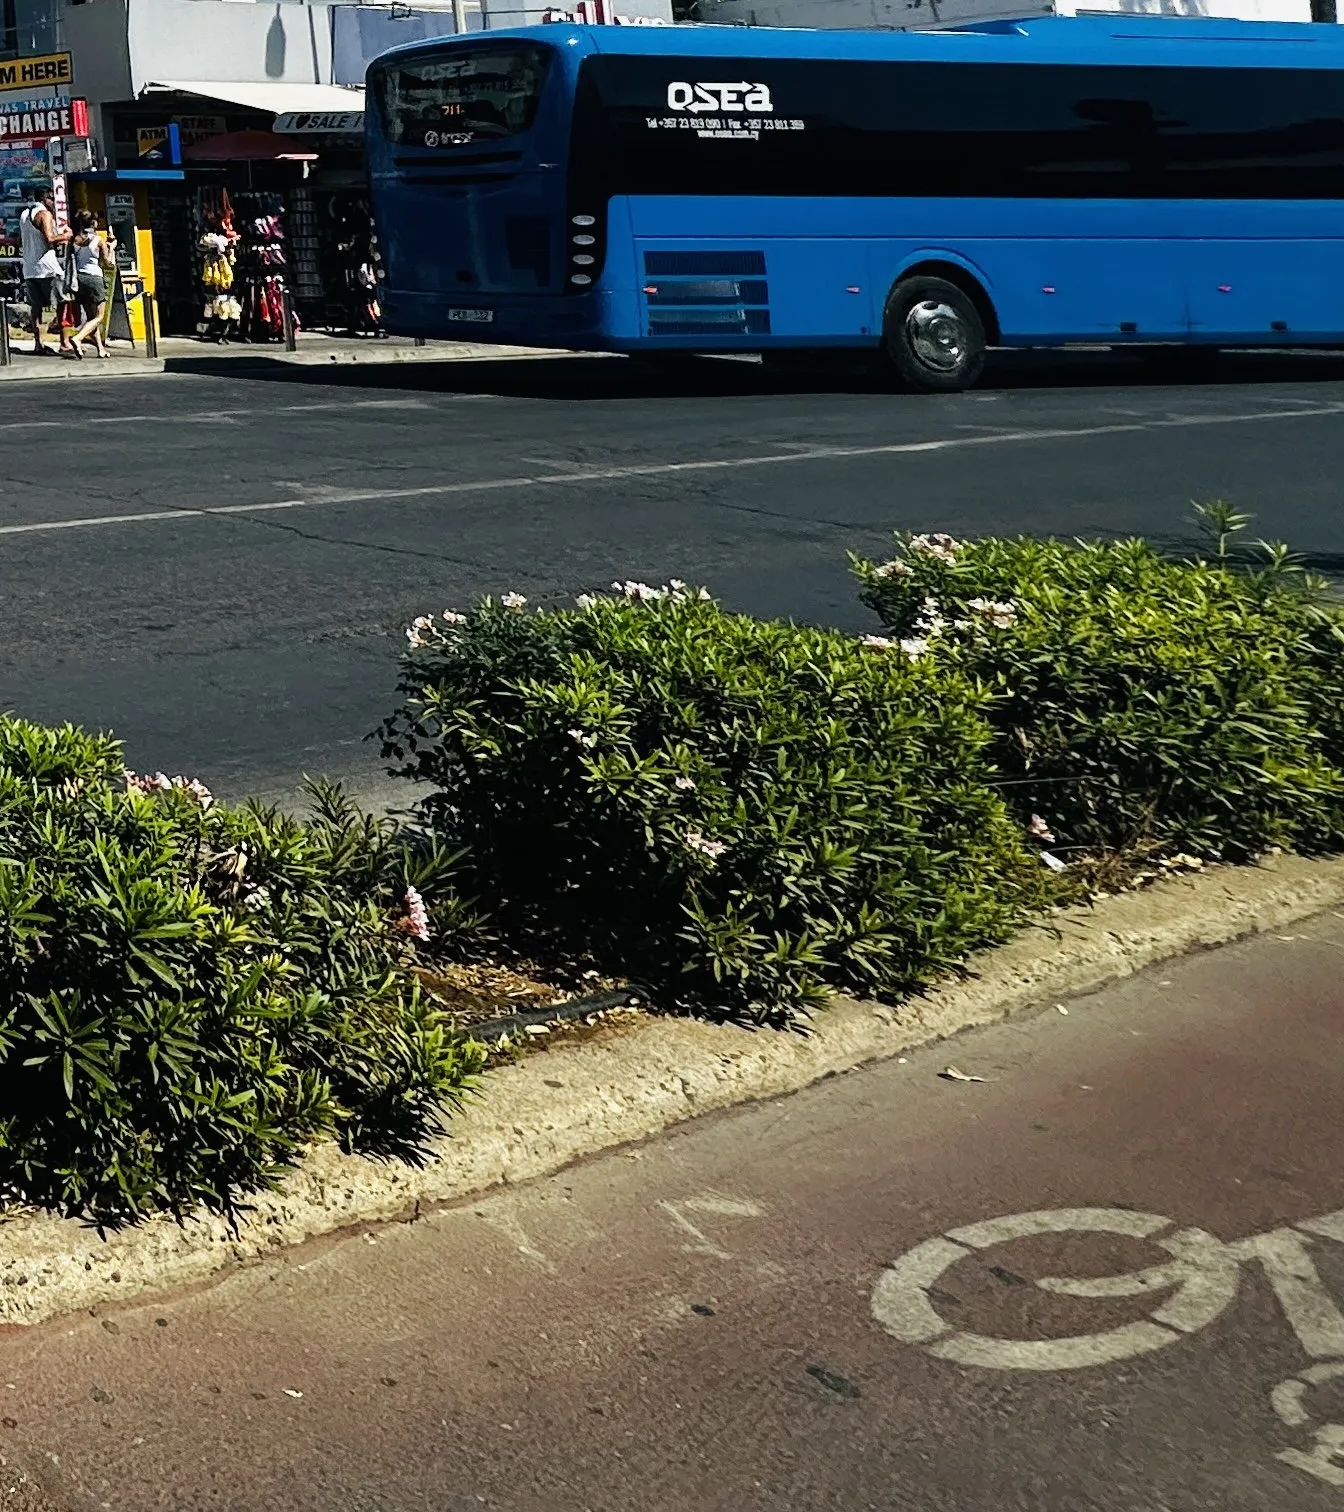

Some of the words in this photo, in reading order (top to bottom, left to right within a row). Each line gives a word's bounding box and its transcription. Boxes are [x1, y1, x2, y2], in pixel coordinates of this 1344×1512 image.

[21, 60, 68, 82] HERE
[24, 97, 69, 112] TRAVEL
[307, 116, 350, 129] SALE
[141, 129, 167, 141] ATM
